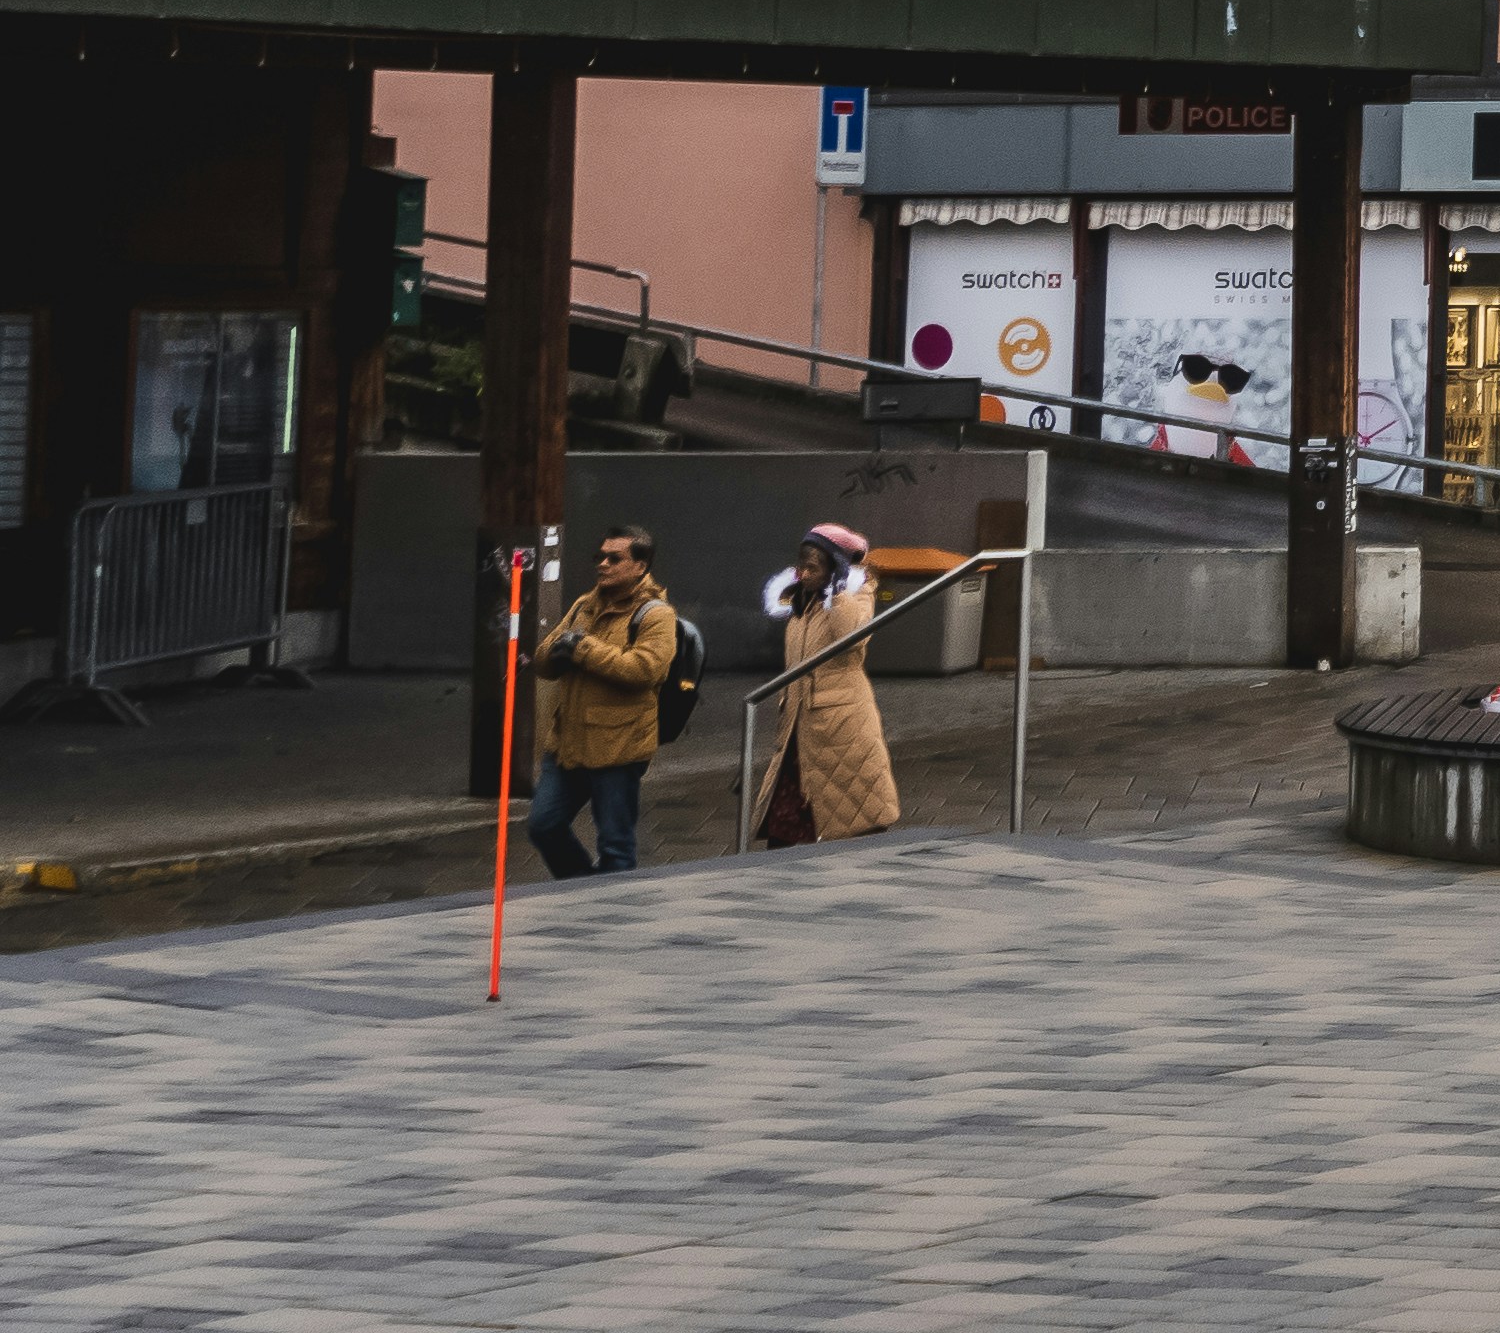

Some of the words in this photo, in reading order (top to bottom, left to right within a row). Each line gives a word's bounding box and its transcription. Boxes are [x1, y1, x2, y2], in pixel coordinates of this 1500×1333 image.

[1188, 106, 1286, 128] POLICE
[962, 269, 1047, 289] swatch
[1214, 268, 1293, 289] swatc
[1213, 295, 1268, 304] SWISS
